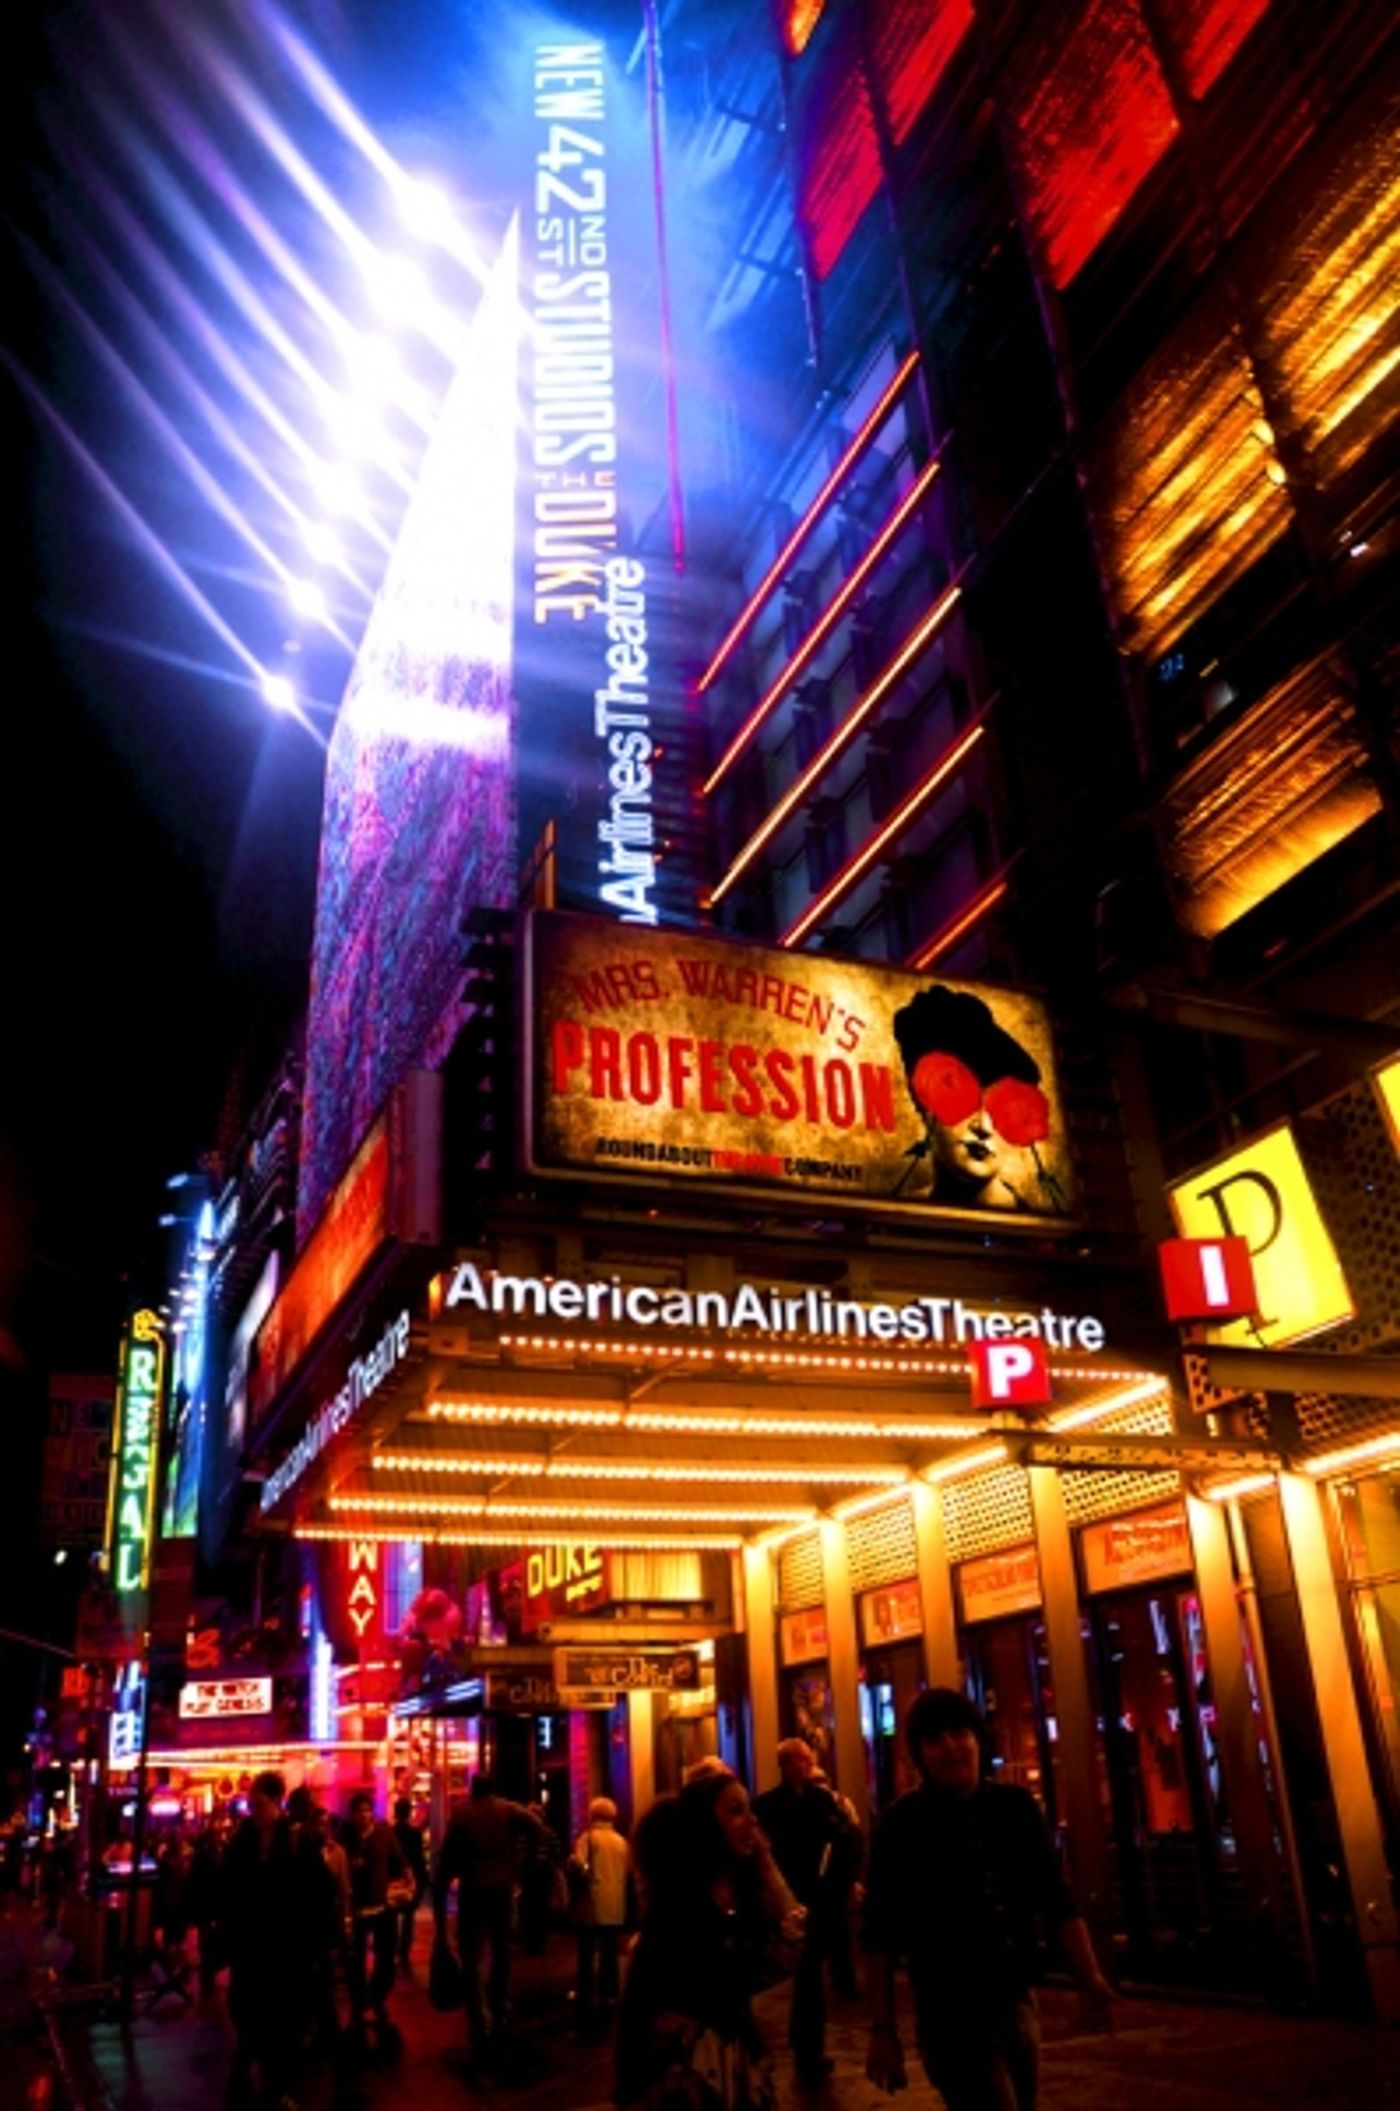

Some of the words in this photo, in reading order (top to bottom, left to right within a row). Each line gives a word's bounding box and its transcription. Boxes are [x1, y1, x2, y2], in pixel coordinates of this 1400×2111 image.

[534, 43, 605, 119] NEW
[535, 124, 606, 213] 42
[533, 269, 617, 466] STUDIOS
[533, 491, 617, 624] DUKE
[677, 960, 866, 1053] WARREN'S
[552, 1018, 896, 1134] PROFESSION
[985, 1345, 1034, 1398] P
